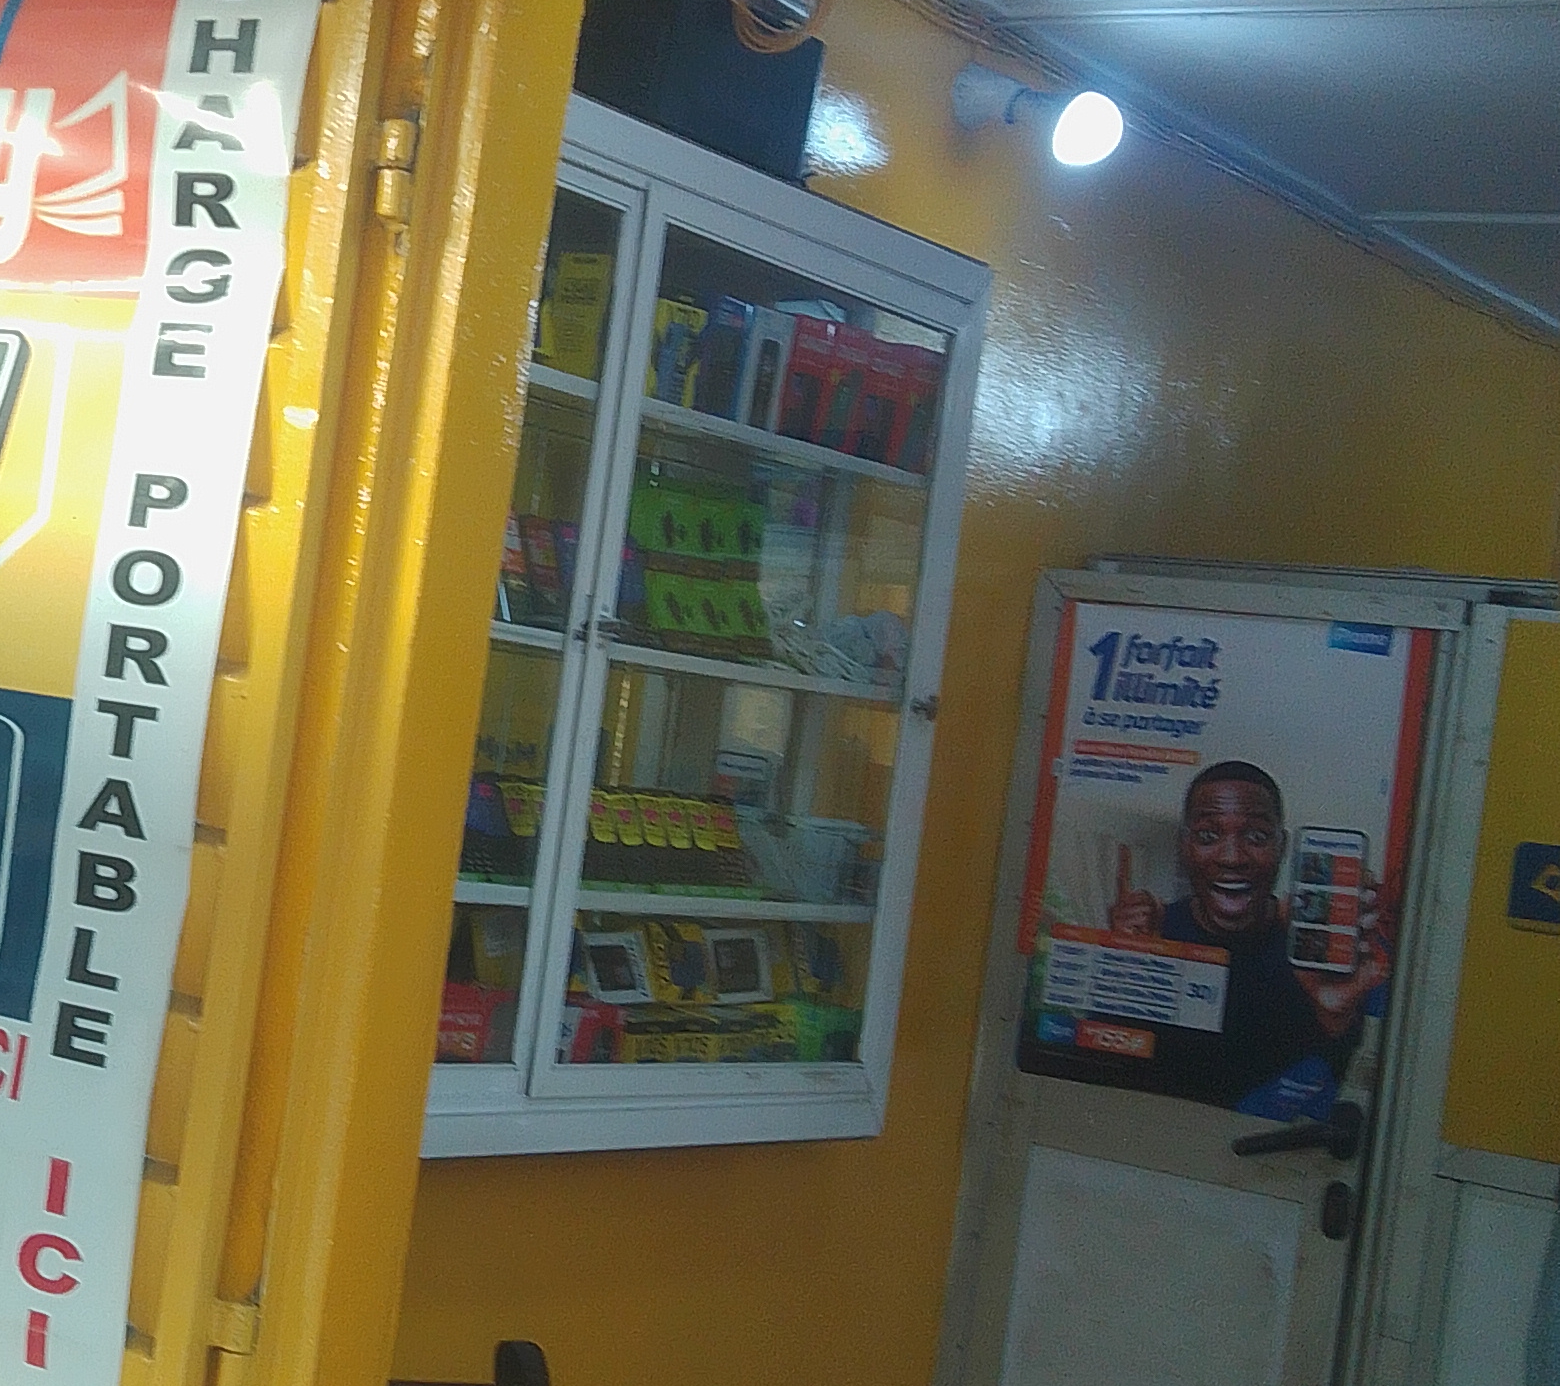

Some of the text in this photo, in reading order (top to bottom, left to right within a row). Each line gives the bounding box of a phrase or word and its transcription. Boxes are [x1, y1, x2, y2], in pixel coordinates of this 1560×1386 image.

[50, 472, 189, 1069] PORTABLE
[1089, 631, 1122, 700] 1
[17, 1157, 83, 1369] ICI
